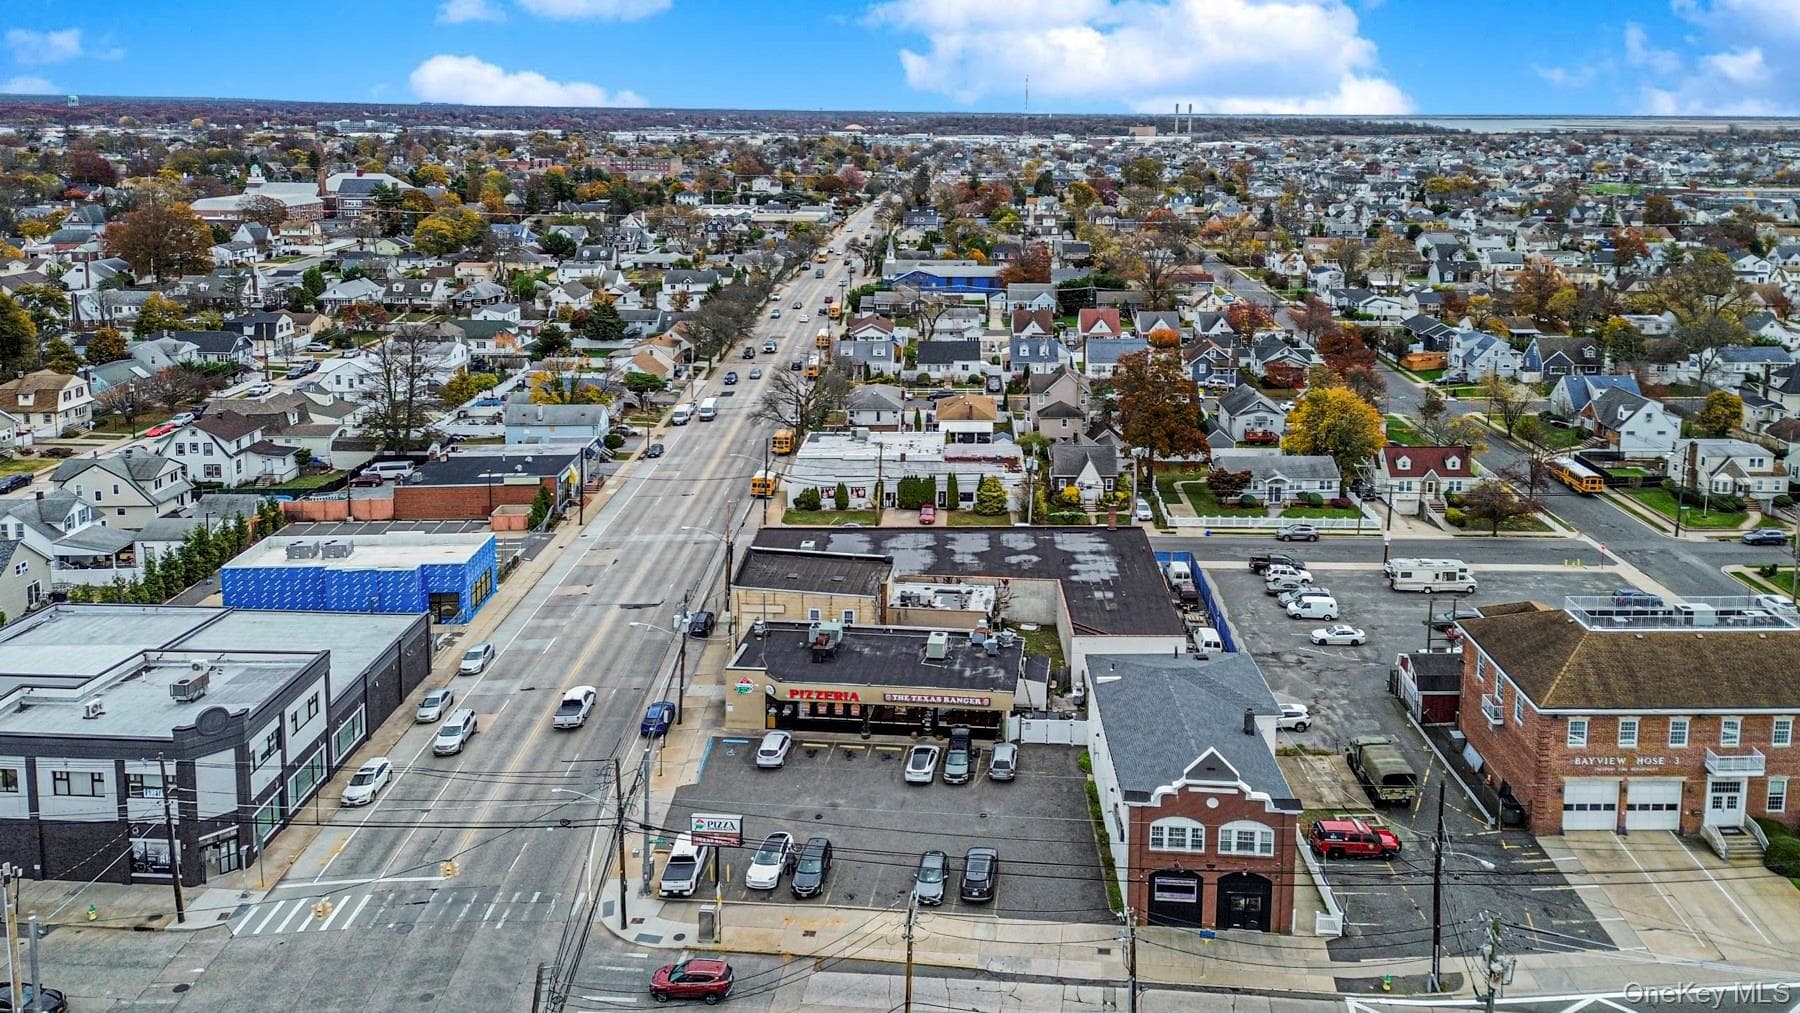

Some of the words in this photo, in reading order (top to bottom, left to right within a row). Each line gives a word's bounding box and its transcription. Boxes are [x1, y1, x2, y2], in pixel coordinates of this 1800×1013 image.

[788, 689, 861, 702] PIZZERIA
[892, 694, 910, 702] THE
[911, 695, 942, 703] TEXAS
[943, 697, 982, 705] RANGER
[1574, 757, 1627, 766] BAYVIEW
[1637, 757, 1665, 765] HOSE
[1674, 757, 1680, 765] 3
[707, 820, 737, 831] PIZZA
